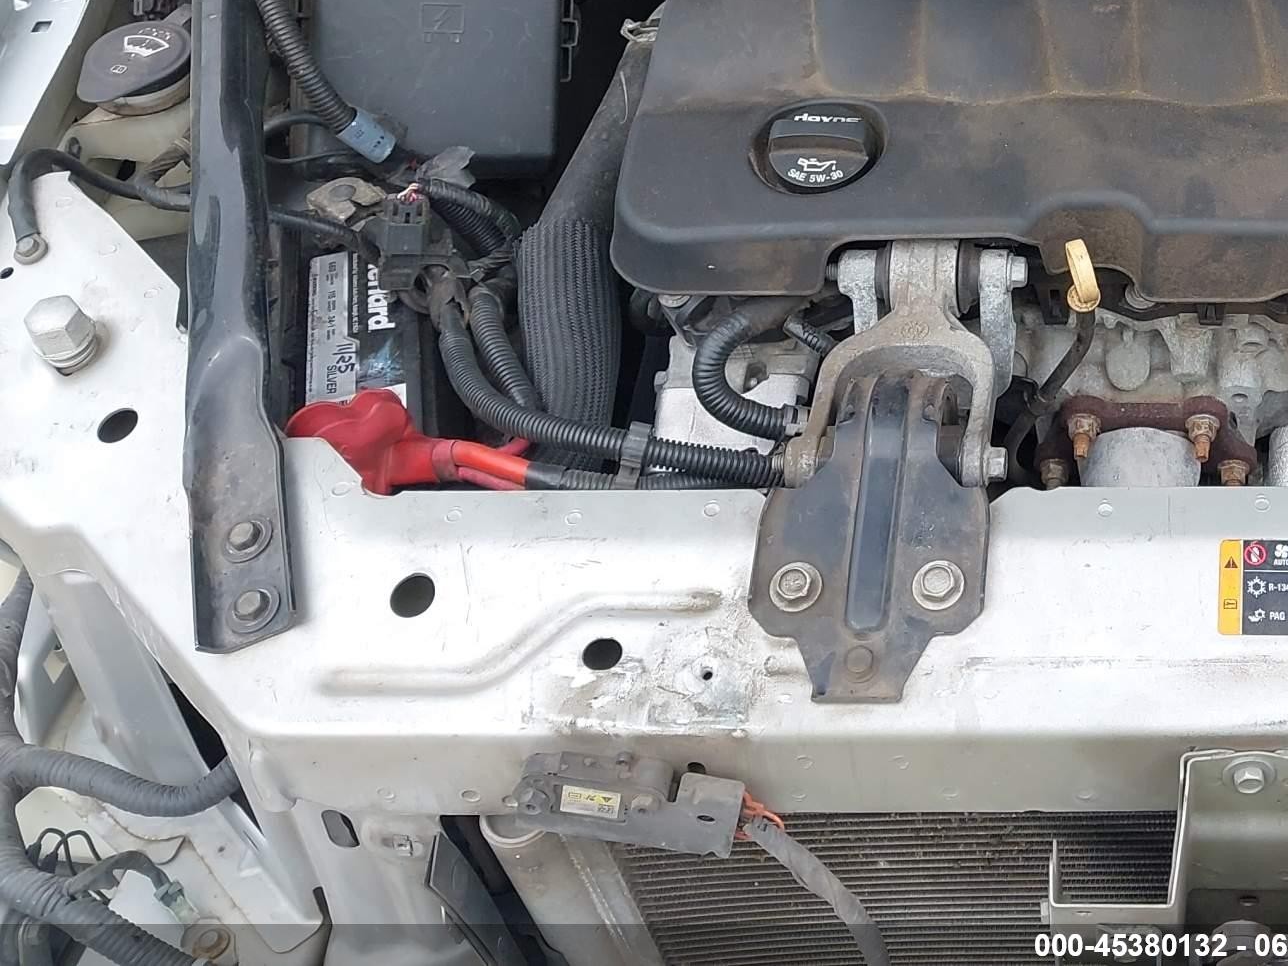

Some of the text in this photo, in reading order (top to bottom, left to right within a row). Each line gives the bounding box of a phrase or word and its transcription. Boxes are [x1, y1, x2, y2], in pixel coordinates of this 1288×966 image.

[788, 168, 843, 183] SAE 5W-30
[326, 365, 337, 395] SILVER
